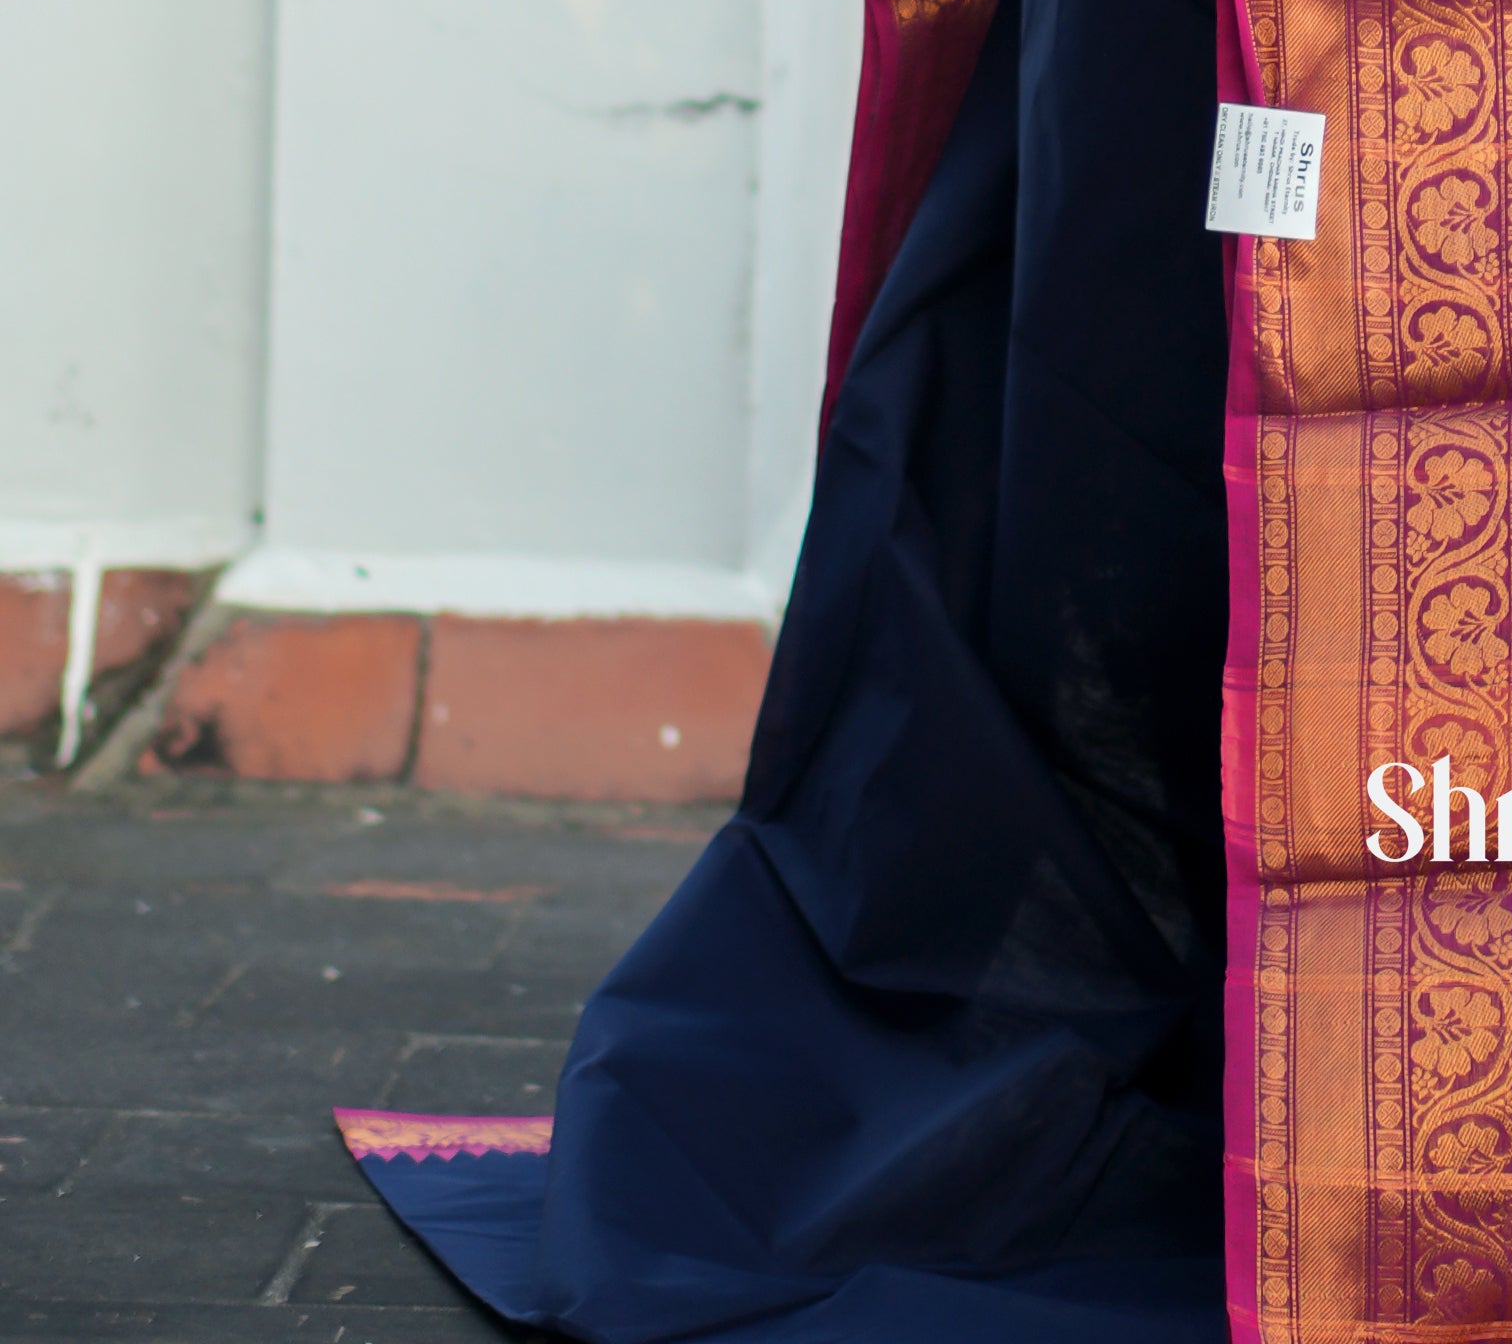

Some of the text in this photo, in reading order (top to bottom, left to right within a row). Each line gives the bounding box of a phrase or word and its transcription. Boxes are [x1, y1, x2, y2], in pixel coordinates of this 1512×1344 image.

[1217, 123, 1226, 149] CLEAN
[1214, 150, 1223, 170] ONLY
[1211, 177, 1219, 201] STEAM
[1293, 142, 1314, 212] Shrus
[1208, 203, 1217, 221] IRON
